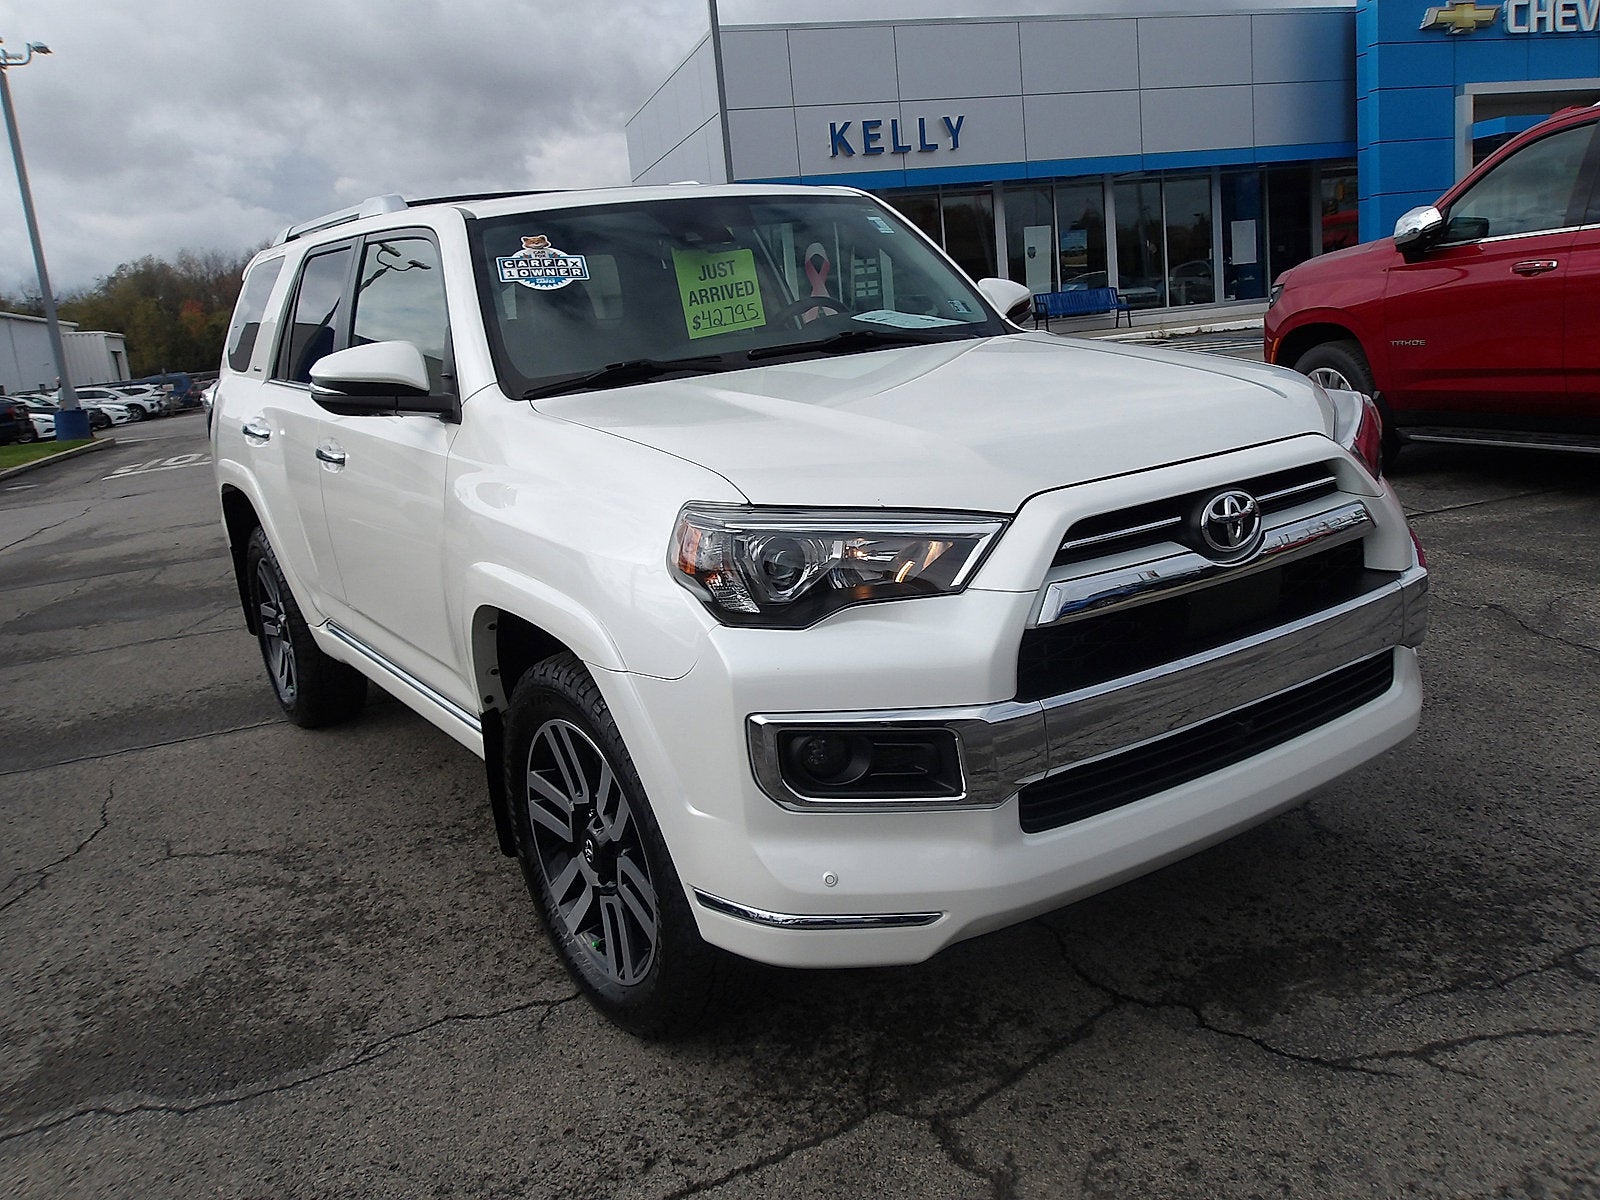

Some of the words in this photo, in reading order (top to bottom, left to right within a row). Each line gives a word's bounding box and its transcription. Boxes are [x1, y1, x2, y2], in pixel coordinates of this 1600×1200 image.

[829, 115, 965, 157] KELLY
[503, 260, 580, 268] CARFAX
[519, 268, 582, 277] OWNER
[698, 260, 735, 281] JUST
[689, 280, 755, 306] ARRIVED
